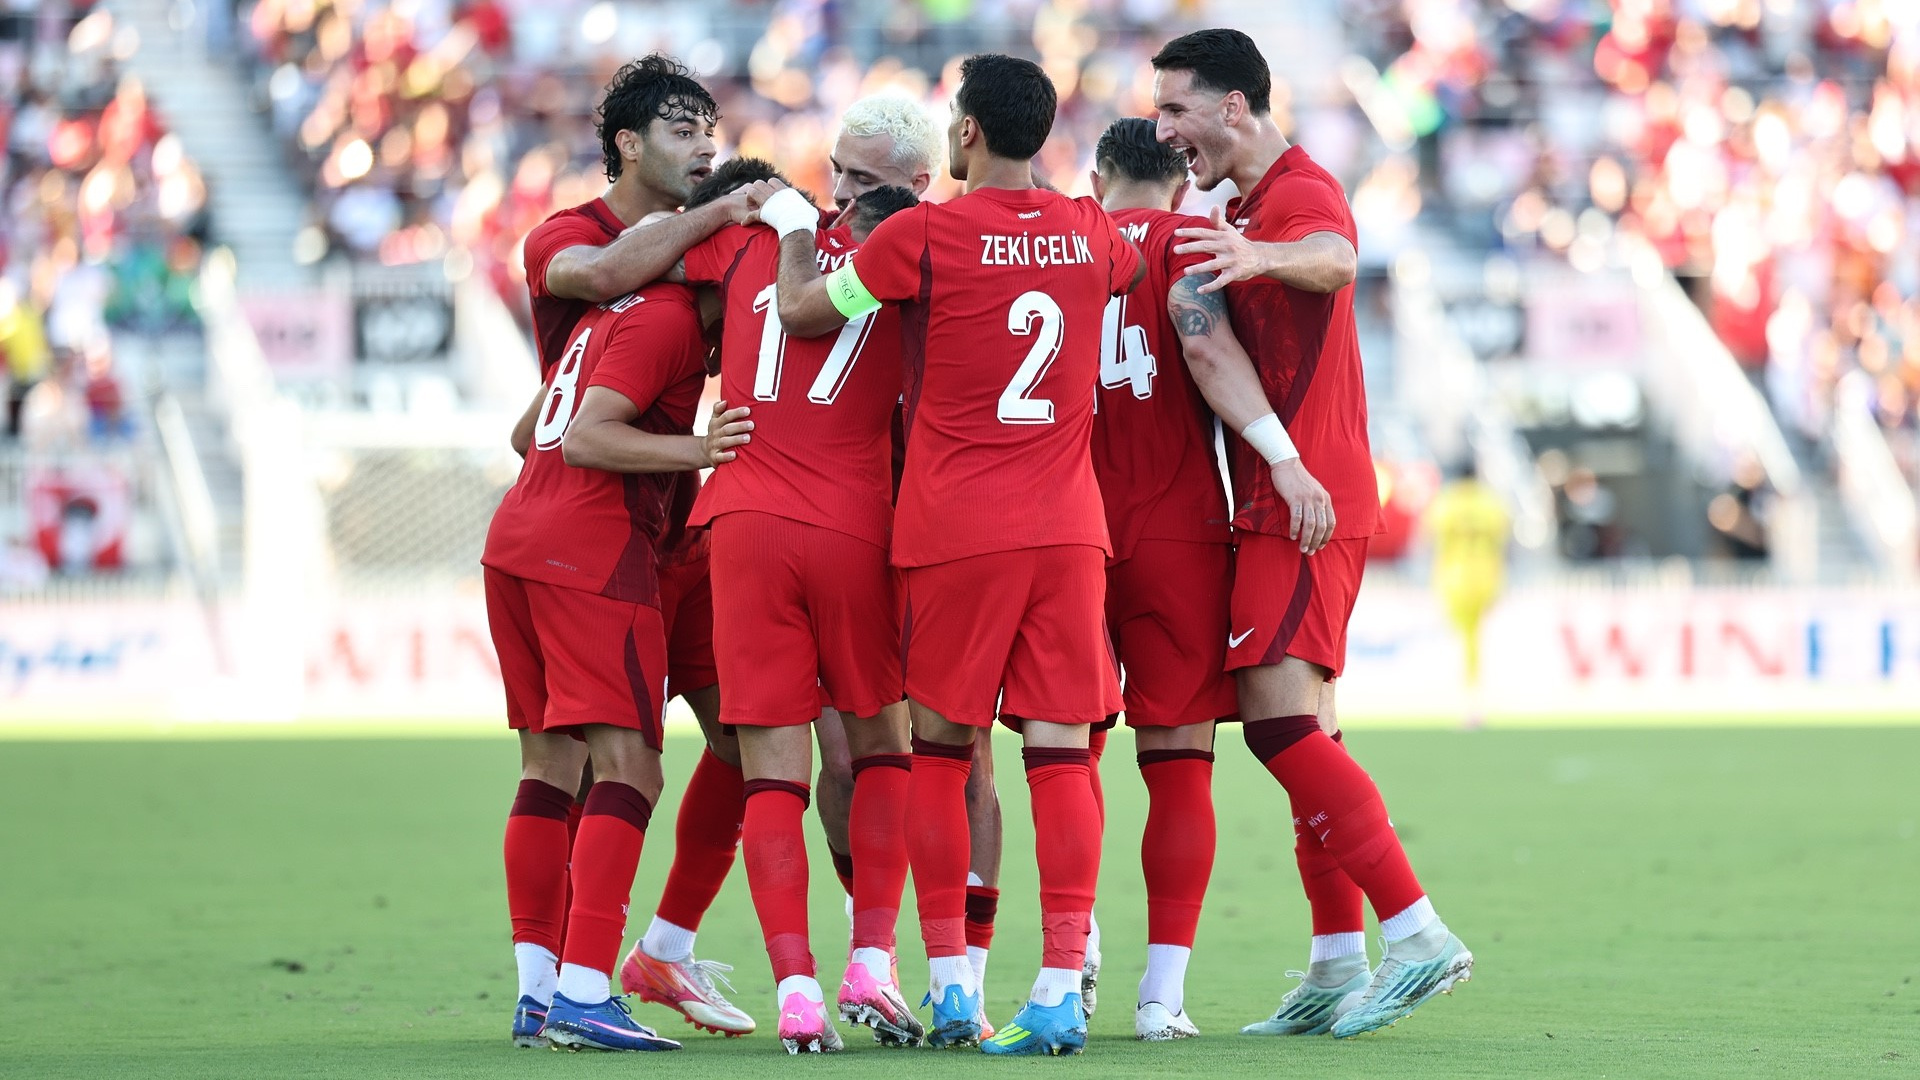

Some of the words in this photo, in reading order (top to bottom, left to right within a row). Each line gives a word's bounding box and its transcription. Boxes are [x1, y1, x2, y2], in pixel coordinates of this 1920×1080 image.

[840, 273, 856, 300] SPECT
[980, 231, 1030, 265] ZEKİ
[1033, 230, 1095, 268] ÇELİK
[535, 327, 593, 451] 8
[997, 290, 1065, 425] 2
[1093, 294, 1158, 414] 4
